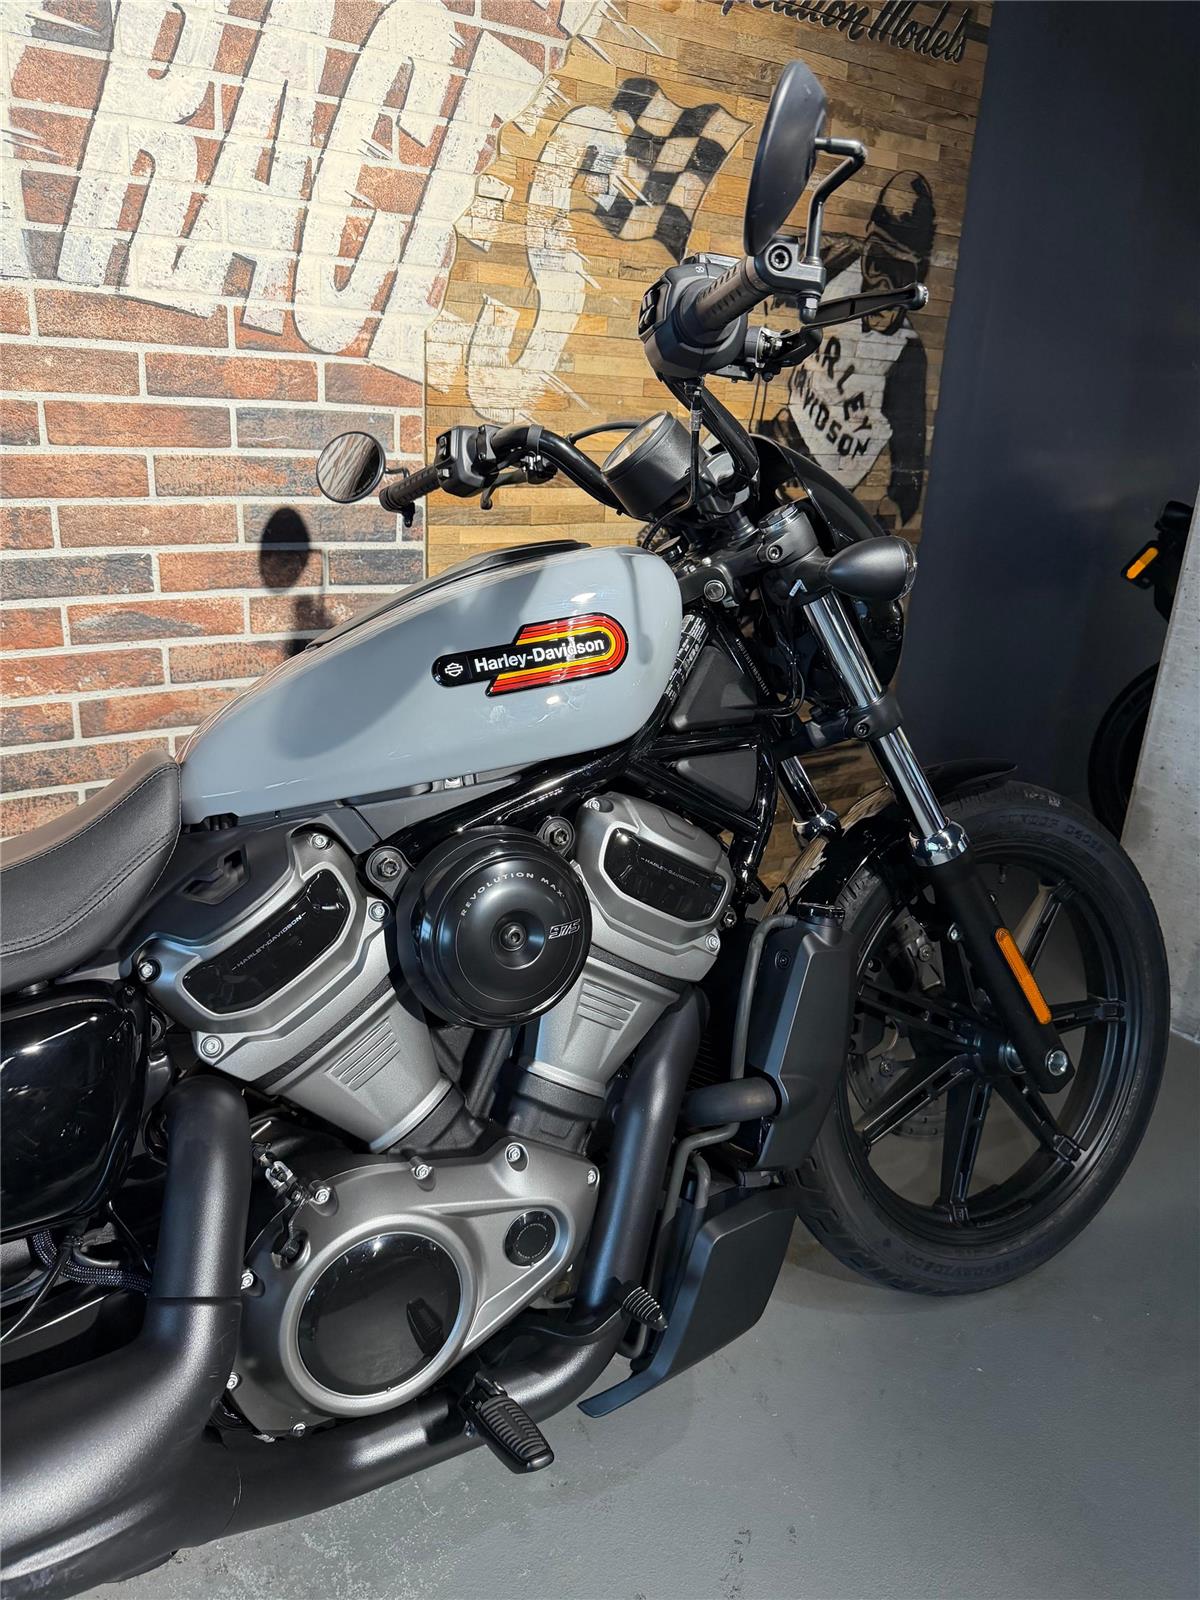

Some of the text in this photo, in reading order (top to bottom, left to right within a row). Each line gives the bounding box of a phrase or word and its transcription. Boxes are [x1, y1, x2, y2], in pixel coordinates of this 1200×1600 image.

[867, 0, 972, 64] Models
[474, 638, 605, 673] Harley-Davidson
[460, 872, 563, 917] REVOLUTION MAX
[236, 914, 303, 968] HARLEY-DAVIDSON
